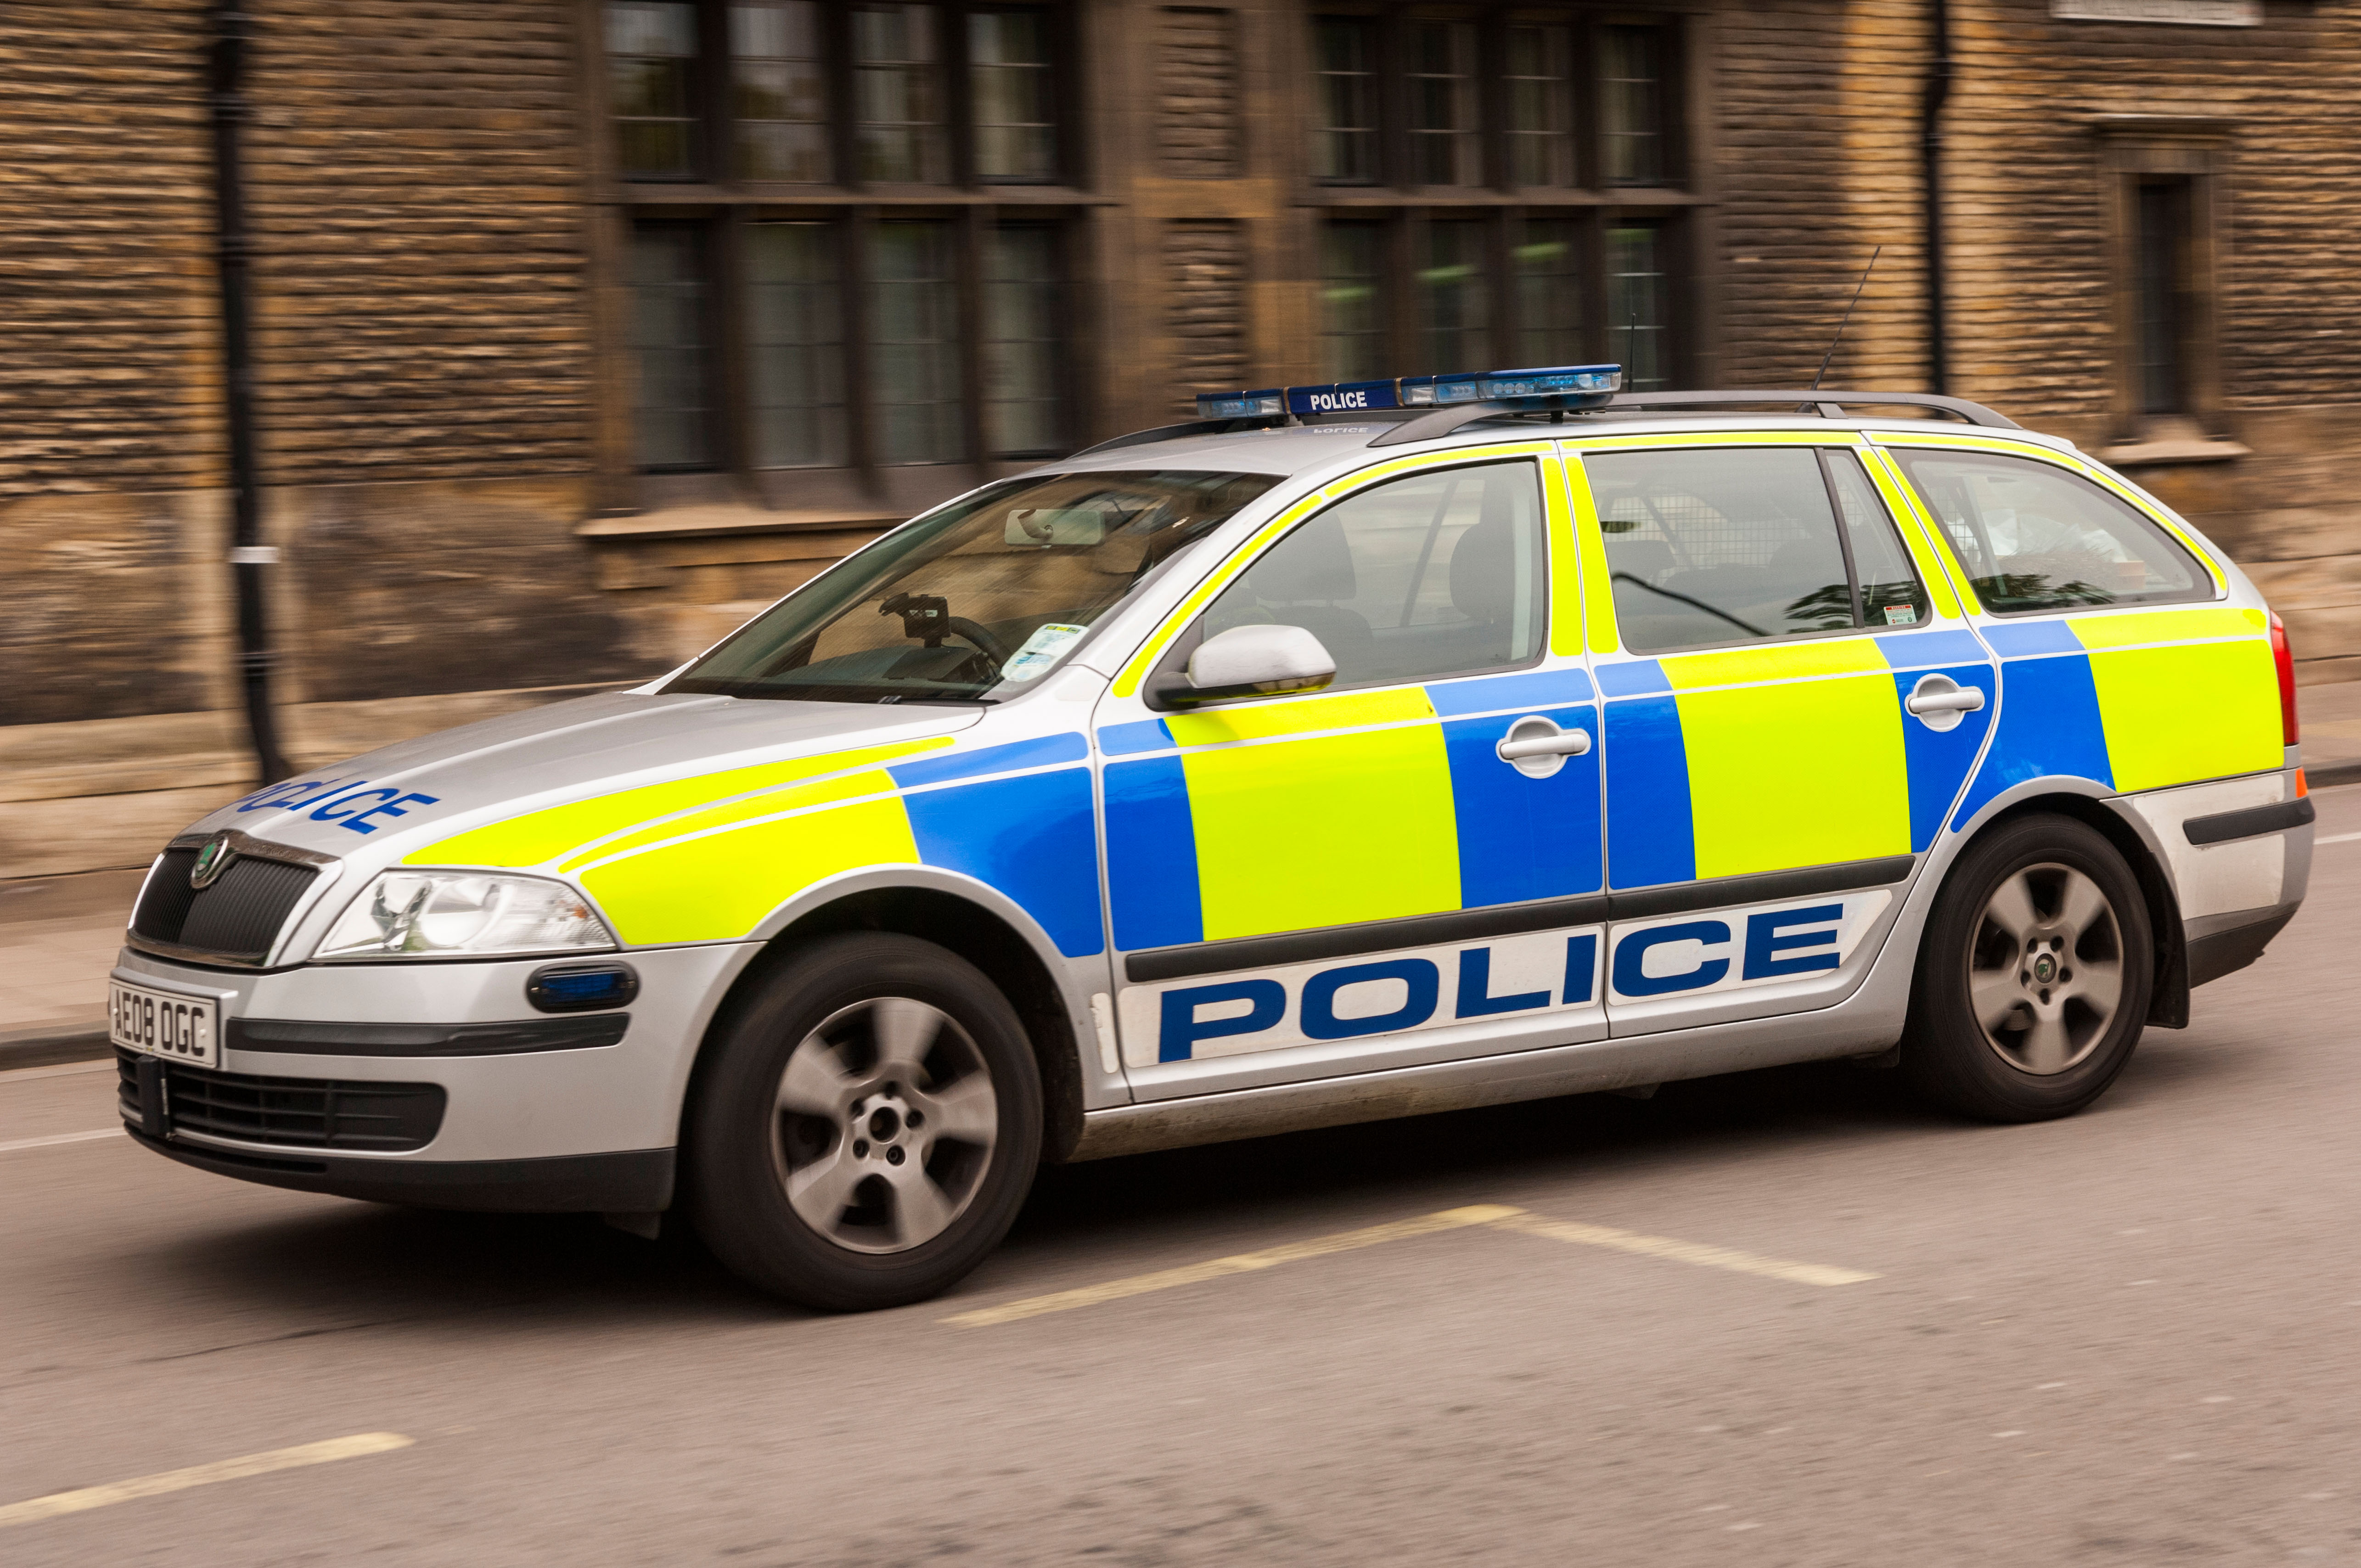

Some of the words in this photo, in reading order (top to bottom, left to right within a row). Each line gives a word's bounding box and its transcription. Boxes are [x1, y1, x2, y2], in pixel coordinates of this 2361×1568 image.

[1310, 391, 1367, 410] POLICE
[1158, 902, 1844, 1064] POLICE
[115, 989, 154, 1046] AE08
[161, 1001, 205, 1057] OGC
